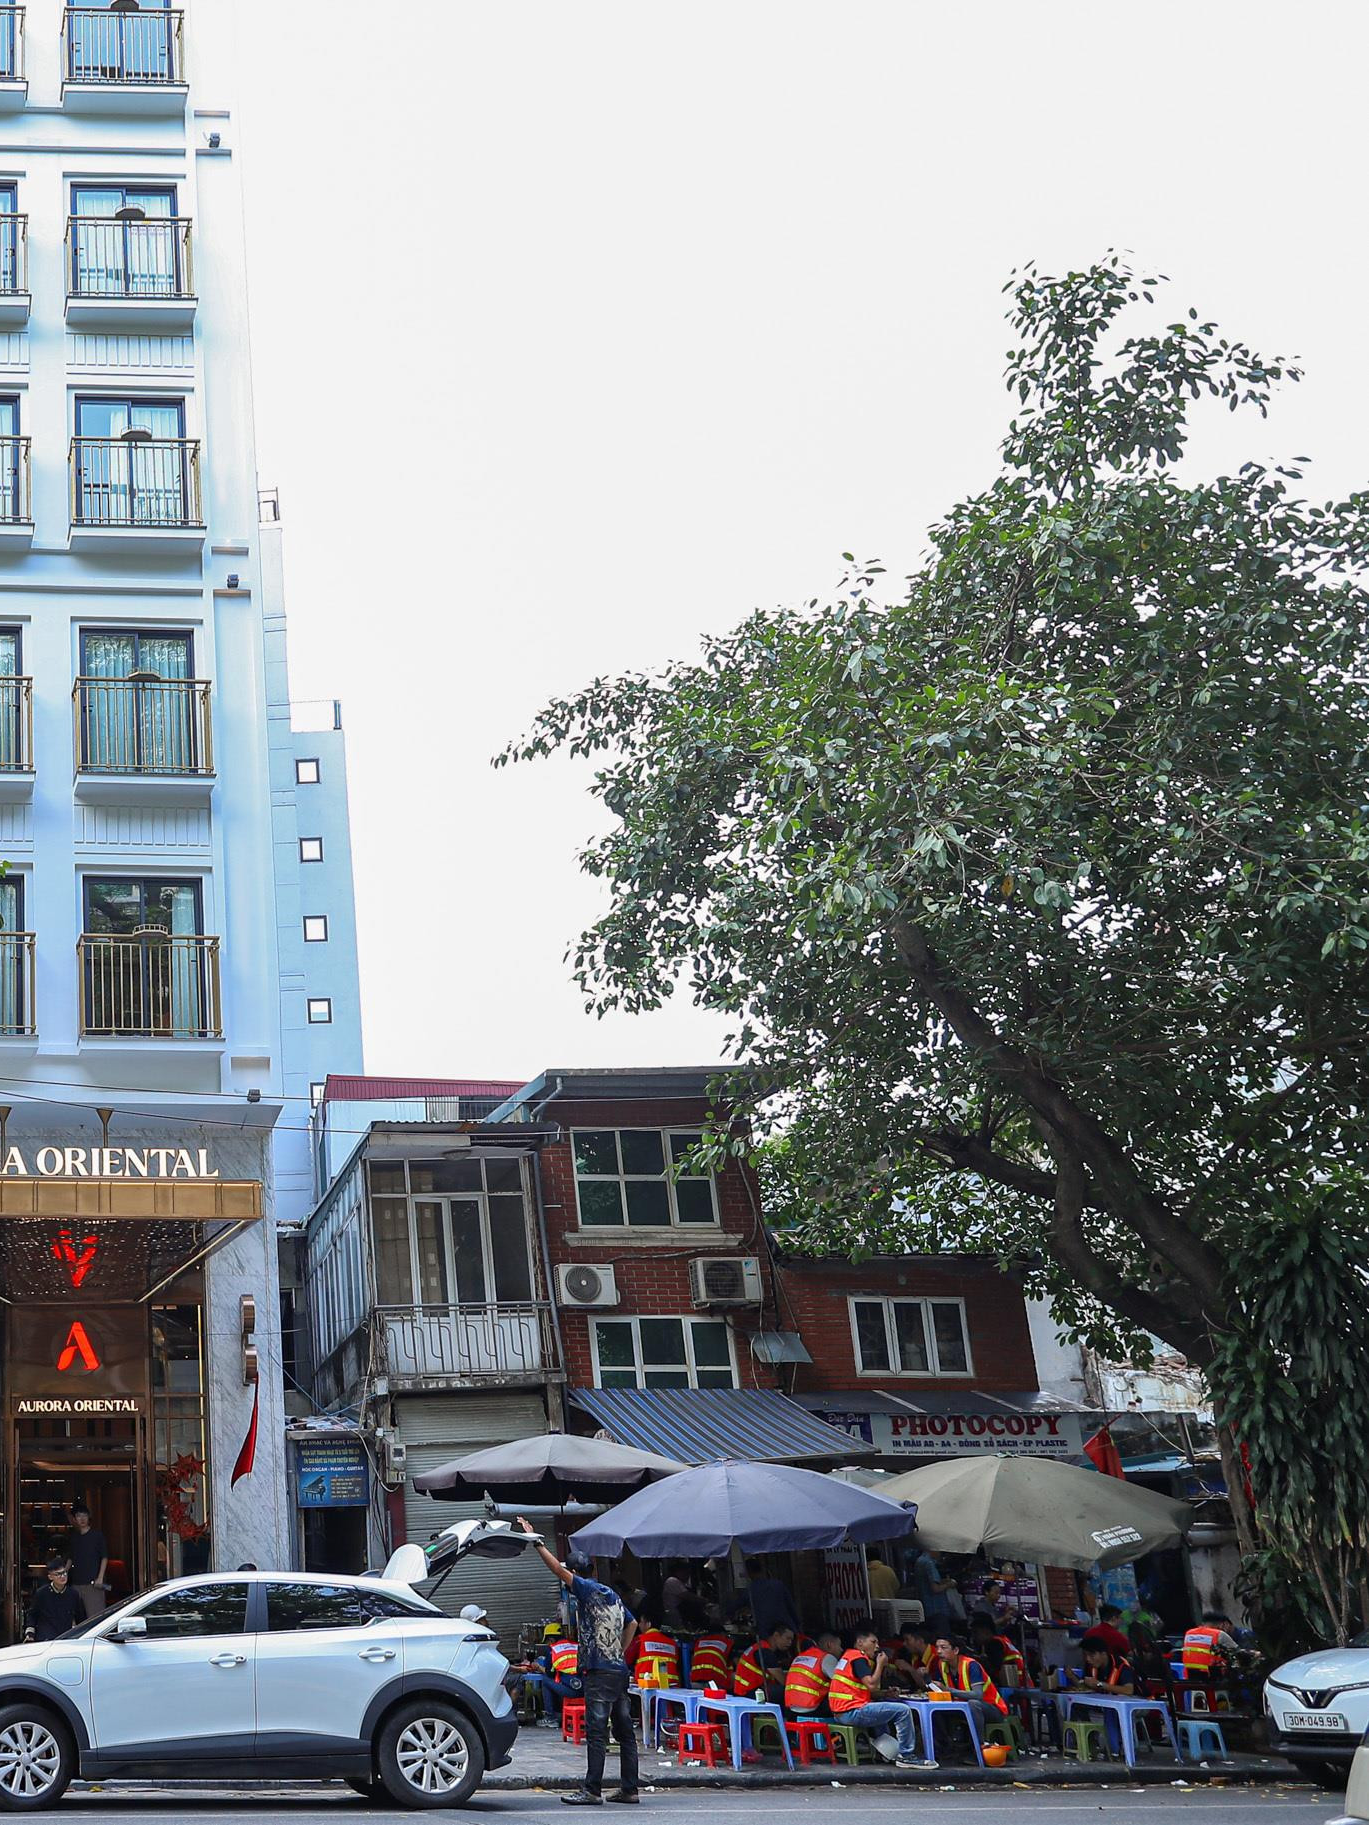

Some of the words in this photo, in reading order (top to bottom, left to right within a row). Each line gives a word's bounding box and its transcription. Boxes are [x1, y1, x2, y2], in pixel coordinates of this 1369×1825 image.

[36, 1147, 220, 1177] ORIENTAL
[18, 1400, 71, 1412] AURORA
[74, 1400, 138, 1412] ORIENTAL
[889, 1414, 1062, 1436] PHOTOCOPY
[1036, 1439, 1068, 1447] PLASTIC
[1288, 1715, 1339, 1727] 30M-049.98
